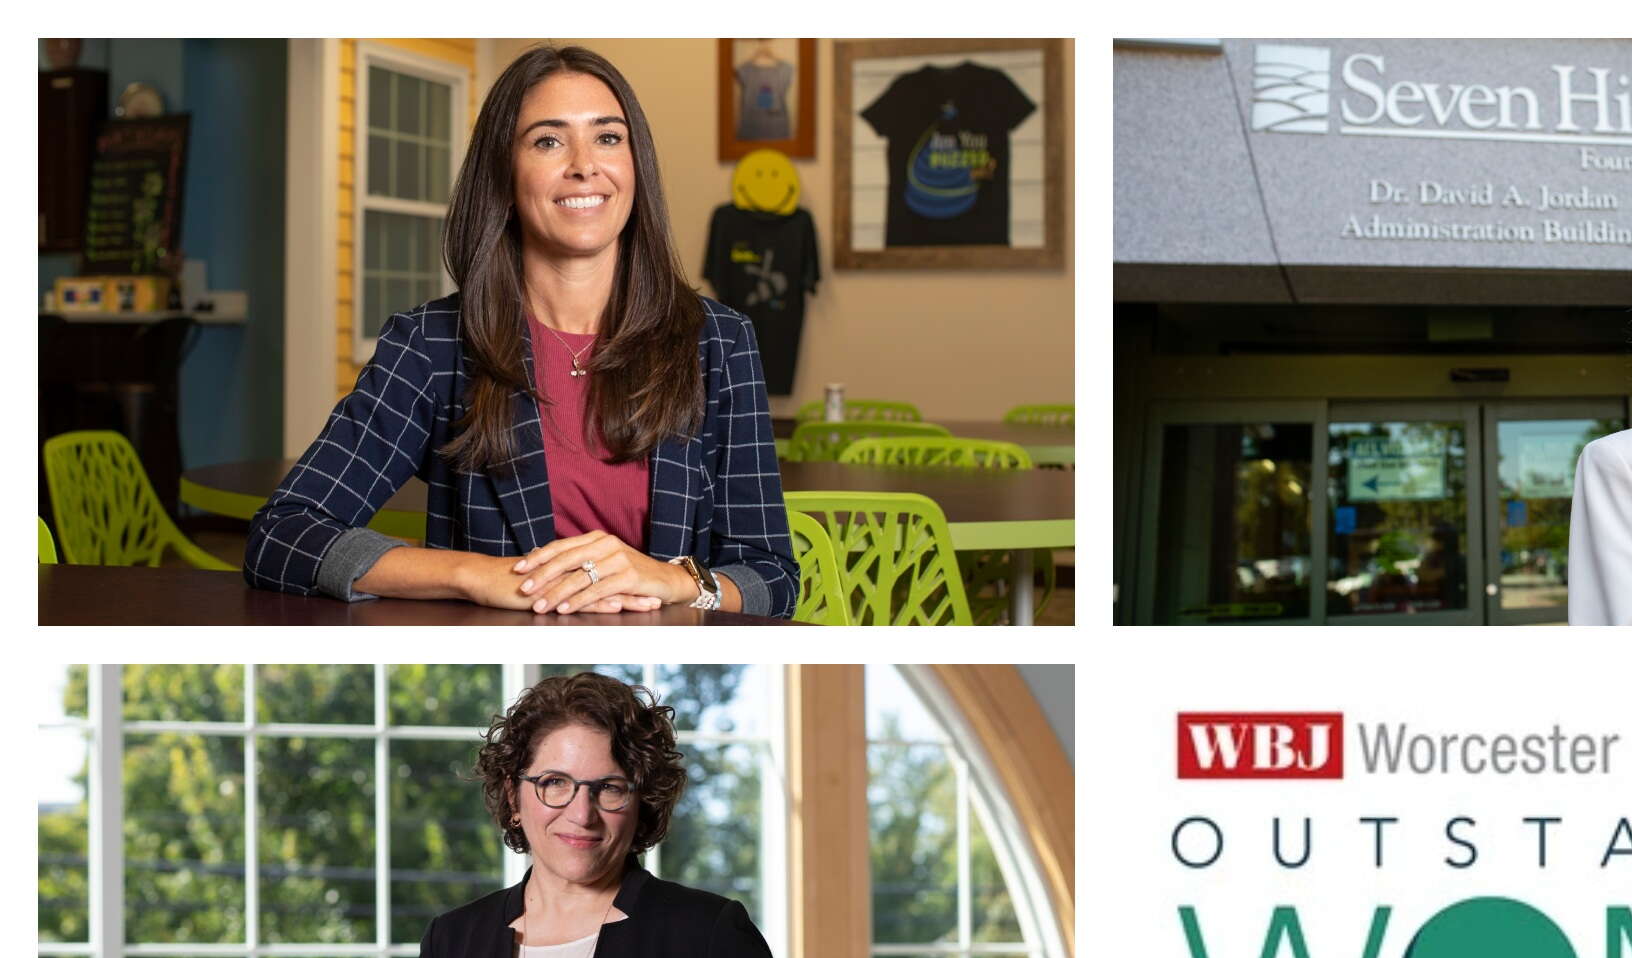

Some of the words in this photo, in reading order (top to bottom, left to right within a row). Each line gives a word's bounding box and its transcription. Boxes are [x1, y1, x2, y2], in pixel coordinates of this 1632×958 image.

[1341, 53, 1543, 131] Seven
[1369, 179, 1408, 204] Dr.
[1418, 180, 1494, 207] David
[1501, 185, 1530, 209] A.
[1538, 186, 1619, 212] Jordan
[1340, 214, 1536, 241] Administration
